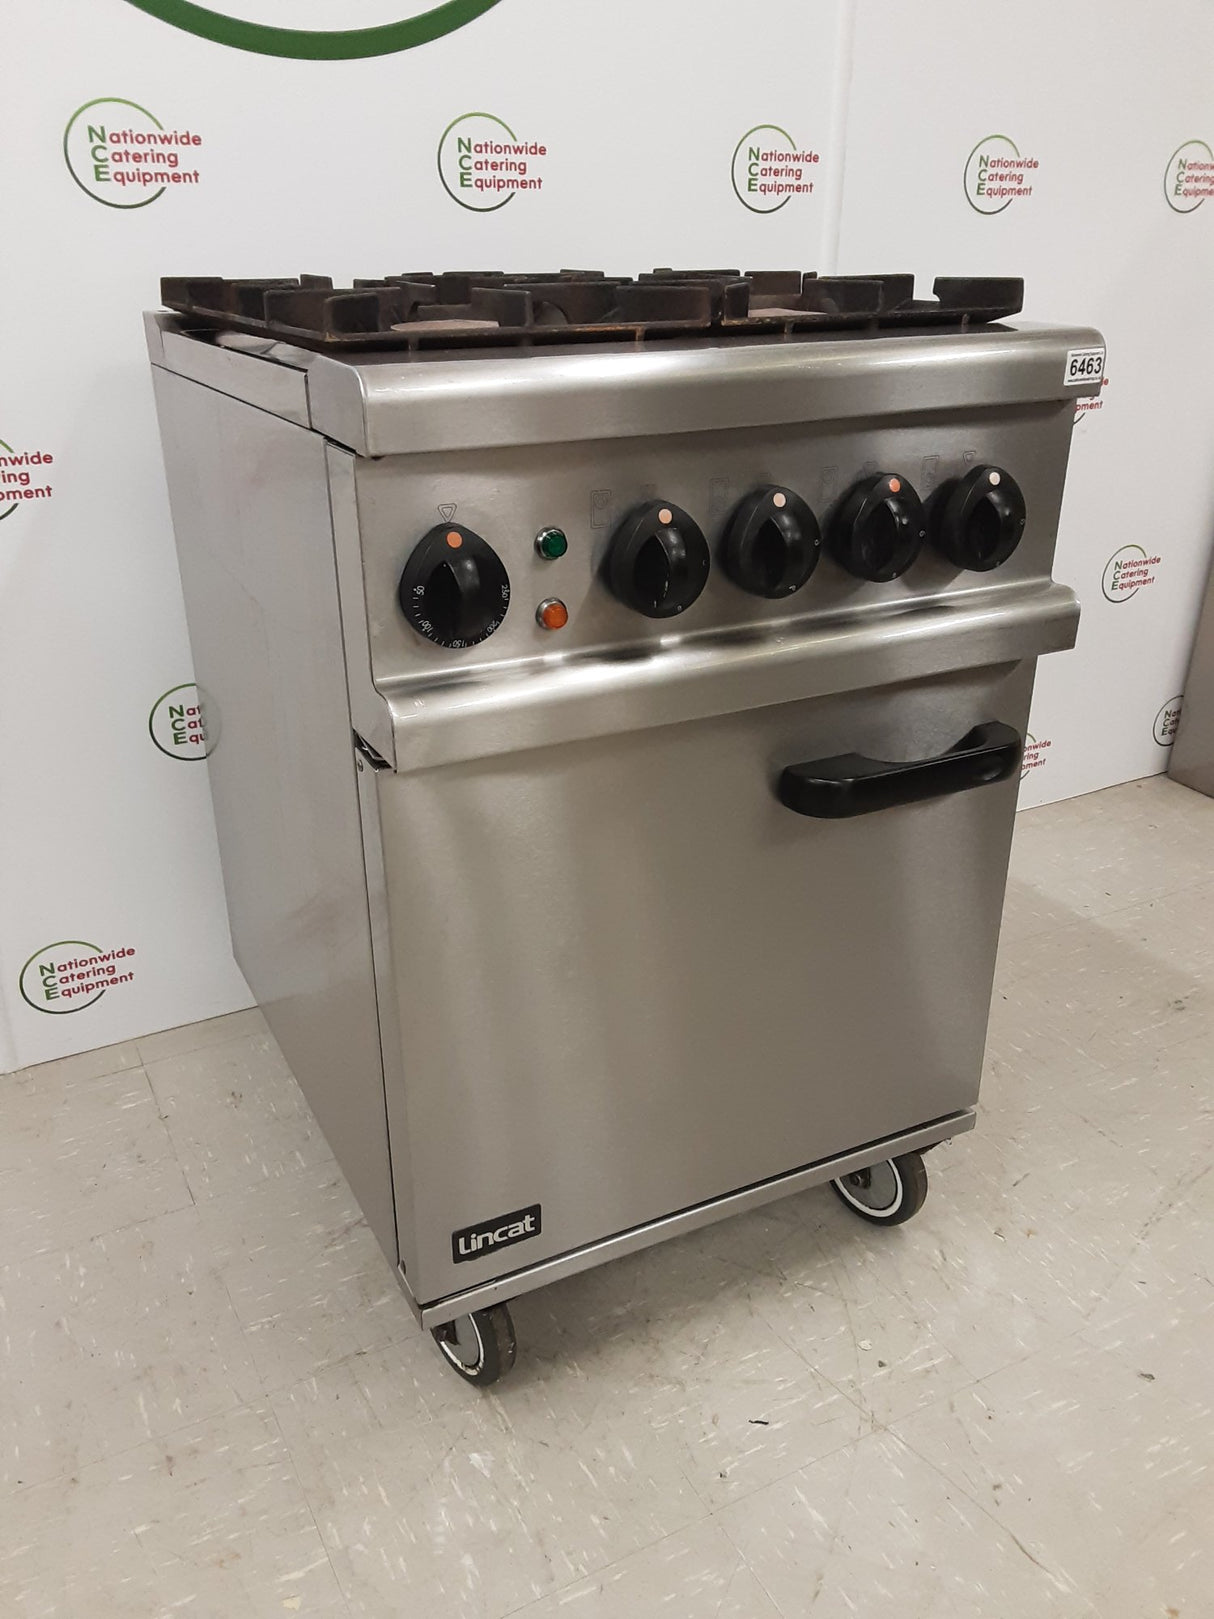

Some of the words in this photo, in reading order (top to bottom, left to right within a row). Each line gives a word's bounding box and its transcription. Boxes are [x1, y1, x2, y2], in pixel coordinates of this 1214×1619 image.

[87, 125, 202, 146] Nationwide
[91, 144, 179, 167] Catering
[457, 137, 547, 156] Nationwide
[748, 146, 820, 163] Nationwide
[458, 154, 527, 175] Catering
[748, 162, 803, 180] Catering
[978, 155, 1039, 169] Nationwide
[93, 164, 200, 186] Equipment
[459, 171, 543, 192] Equipment
[977, 169, 1024, 185] Catering
[747, 178, 814, 196] Equipment
[976, 183, 1033, 198] Equipment
[1070, 356, 1103, 376] 6463
[1, 470, 30, 486] ing
[1114, 556, 1161, 571] Nationwide
[1111, 576, 1155, 591] Equipment
[1113, 568, 1149, 581] Catering
[39, 947, 136, 976] Nationwide
[42, 964, 116, 988] Catering
[44, 972, 135, 1001] Equipment
[458, 1214, 536, 1255] Lincat
